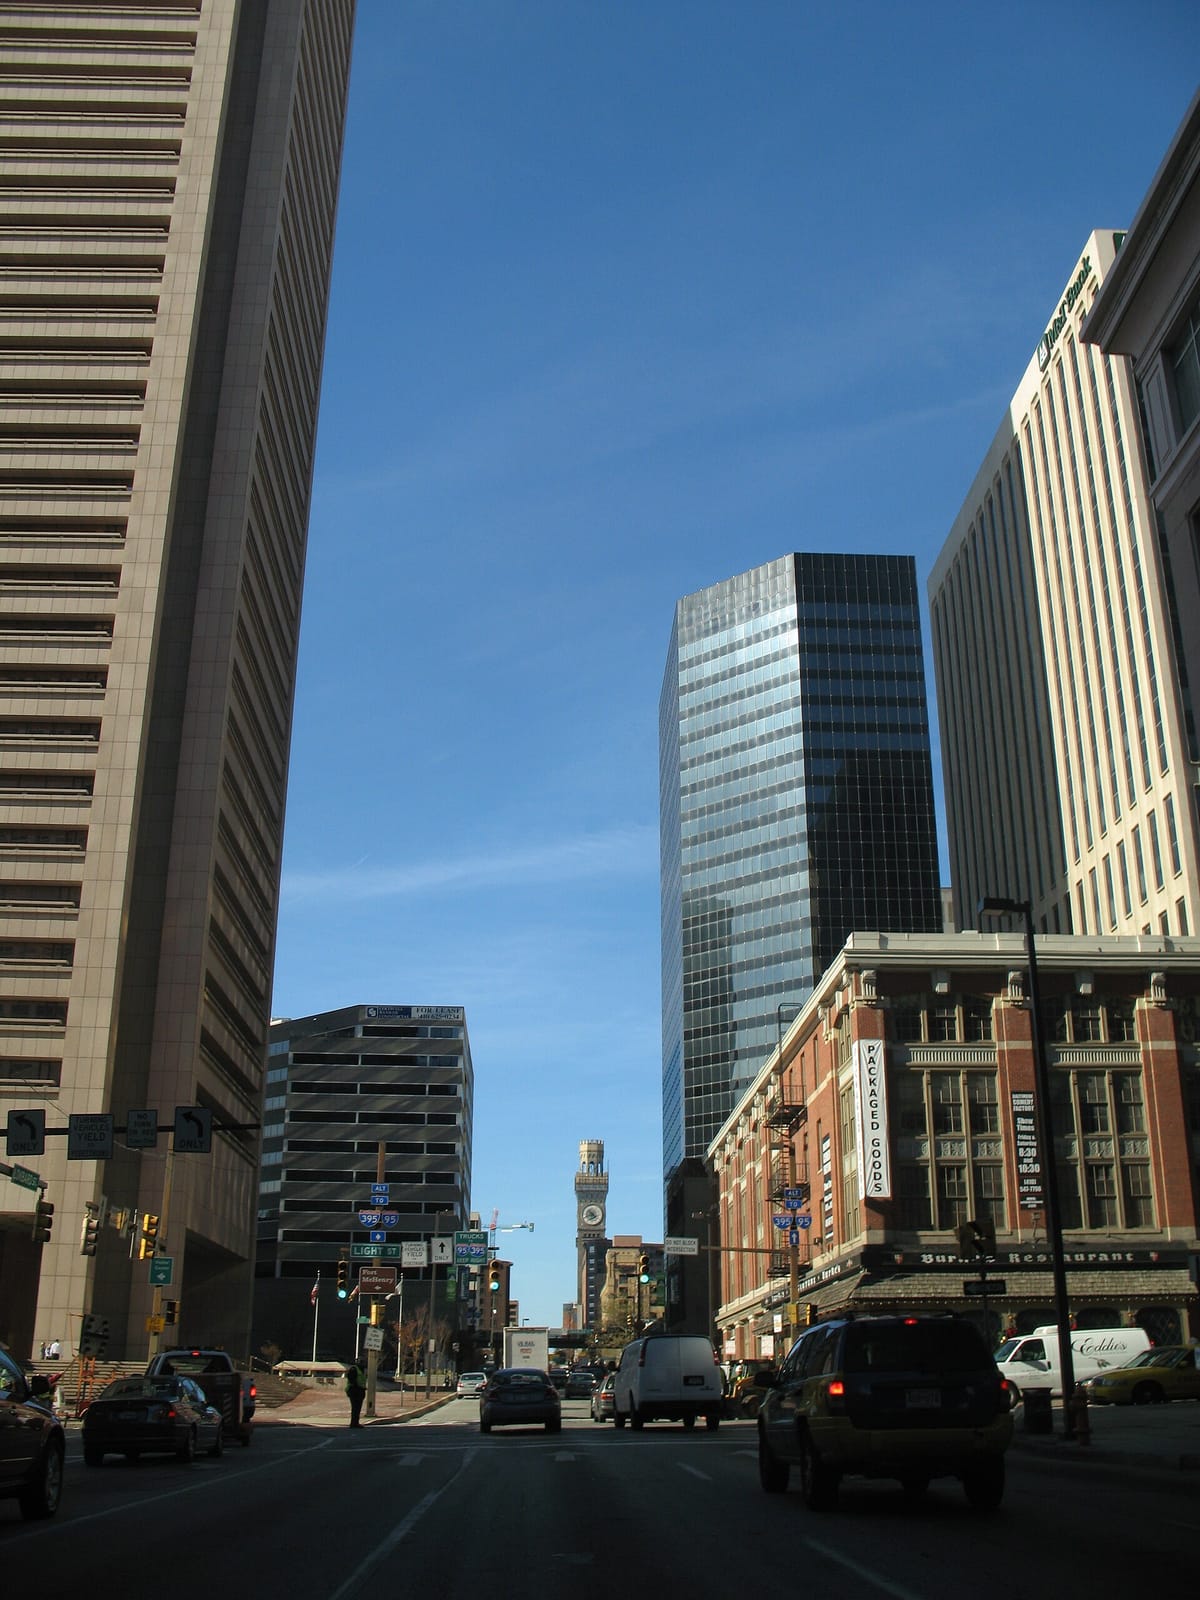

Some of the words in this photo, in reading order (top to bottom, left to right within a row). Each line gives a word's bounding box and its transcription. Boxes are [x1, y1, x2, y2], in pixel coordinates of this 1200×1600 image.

[1065, 256, 1091, 313] Bank
[867, 1045, 880, 1131] PACKAGED
[1016, 1117, 1034, 1125] Show
[73, 1123, 110, 1132] VEHICLES
[1016, 1124, 1035, 1132] Times
[78, 1132, 106, 1141] YIELD
[12, 1142, 38, 1152] ONLY
[179, 1138, 205, 1149] ONLY
[1018, 1147, 1037, 1157] 8:30
[871, 1138, 882, 1193] GOODS
[1018, 1164, 1041, 1174] 10:30
[361, 1215, 378, 1223] 395
[384, 1215, 396, 1223] 95
[775, 1218, 791, 1226] 395
[798, 1218, 810, 1226] 95
[354, 1246, 382, 1256] LIGHT
[387, 1247, 397, 1255] ST
[457, 1246, 468, 1254] 95
[471, 1246, 485, 1254] 395
[1071, 1337, 1128, 1356] Eddie's
